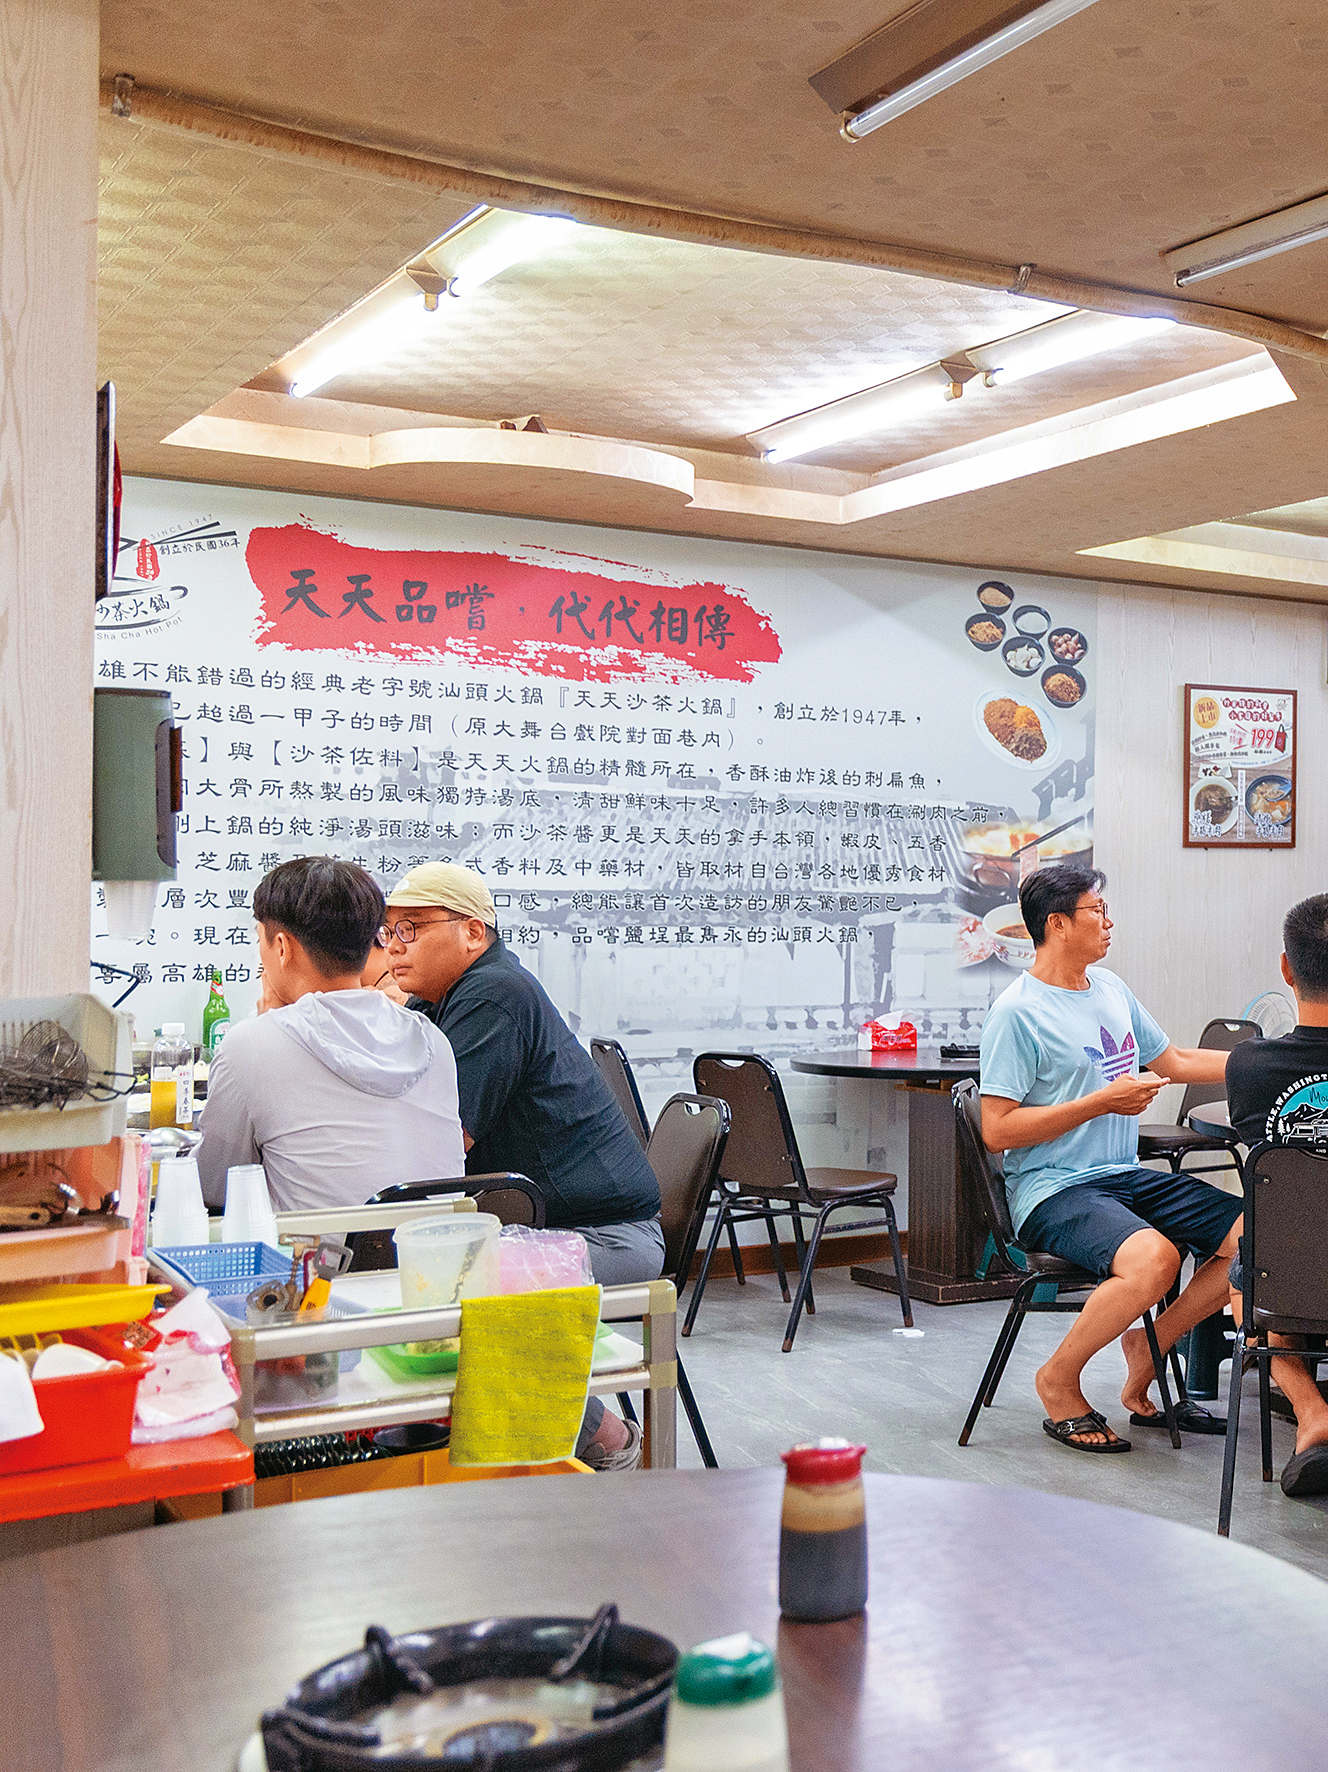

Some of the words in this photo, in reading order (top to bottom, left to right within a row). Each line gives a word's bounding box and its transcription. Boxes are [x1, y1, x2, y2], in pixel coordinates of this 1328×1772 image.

[150, 525, 183, 540] SINCE
[189, 514, 214, 527] 1947
[97, 632, 117, 641] Sha
[121, 628, 142, 640] Cha
[145, 624, 164, 636] Hot
[166, 615, 183, 630] Pot
[1251, 728, 1275, 749] 199
